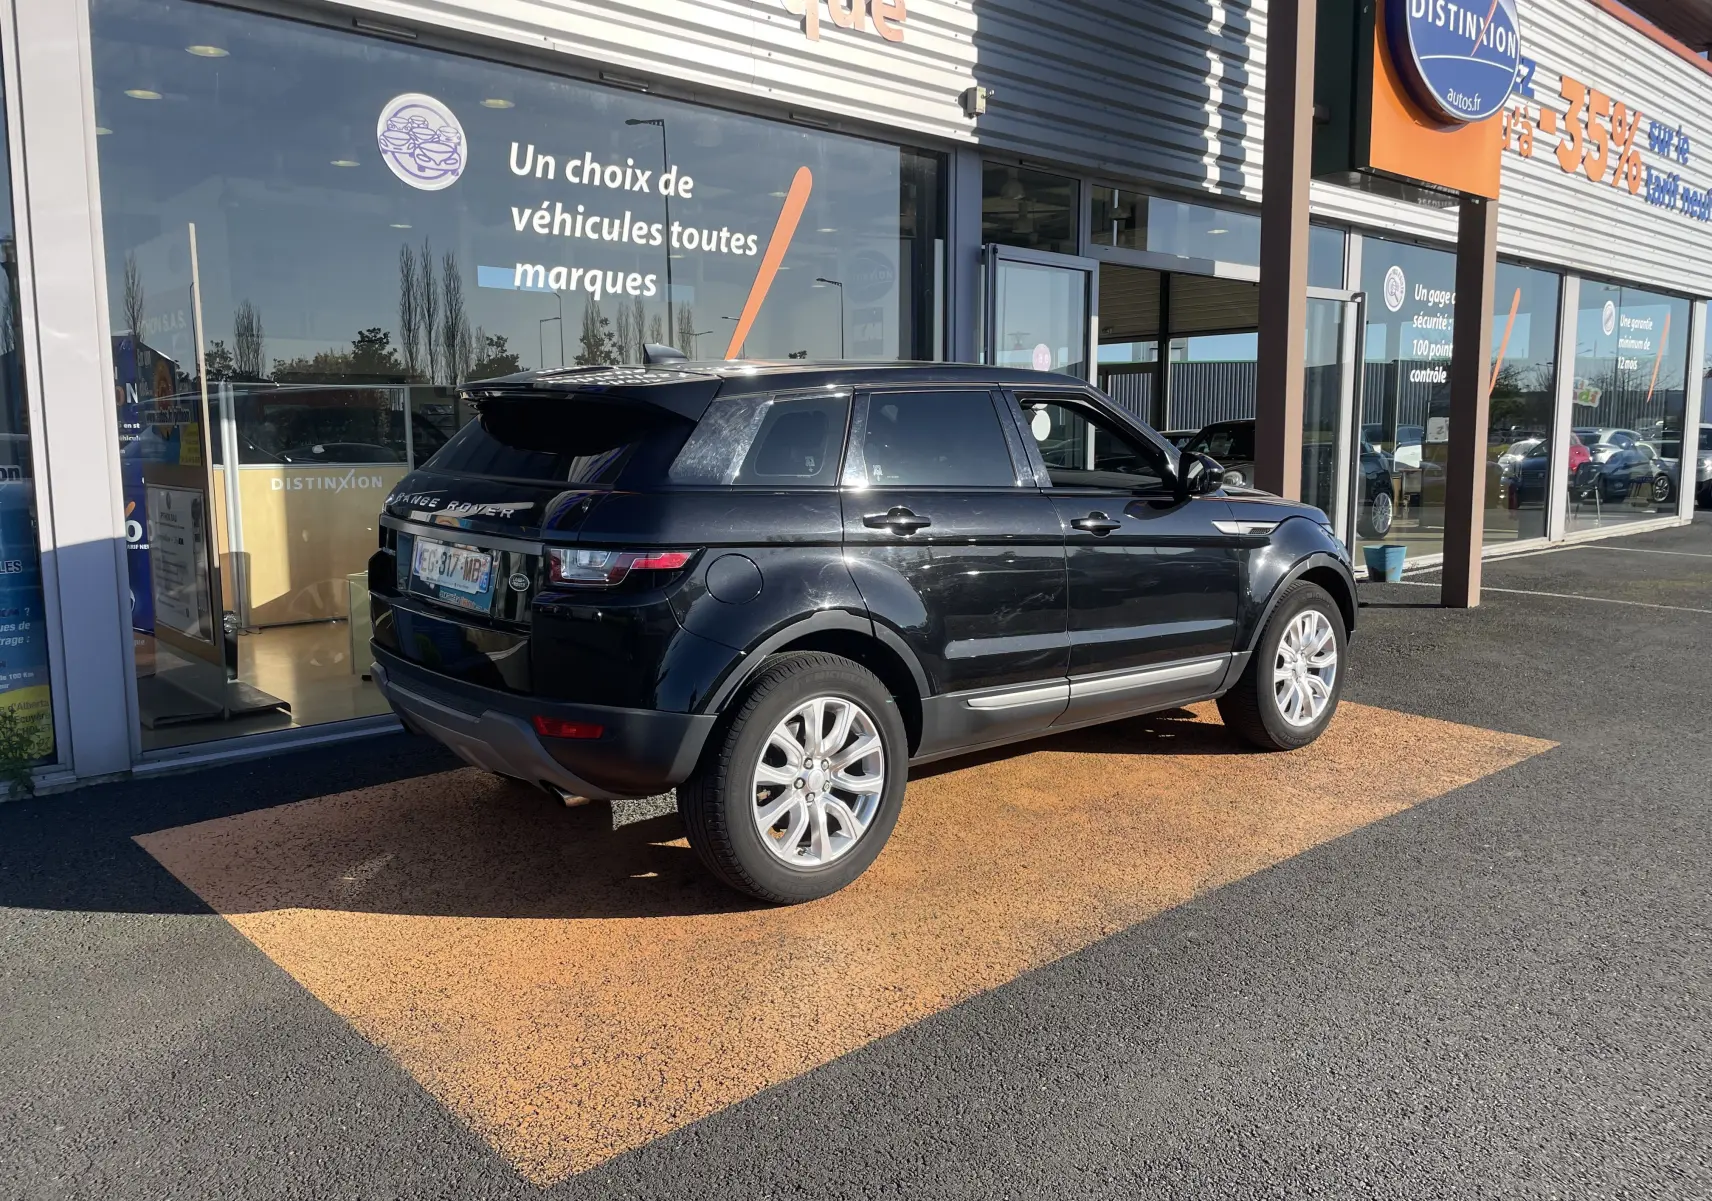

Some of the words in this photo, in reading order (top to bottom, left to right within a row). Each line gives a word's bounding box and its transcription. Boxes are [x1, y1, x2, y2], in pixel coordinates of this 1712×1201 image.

[1411, 0, 1516, 58] DISTINXION
[1447, 88, 1481, 111] autos.fr
[1649, 121, 1674, 158] sur
[1676, 125, 1690, 165] le
[509, 142, 555, 180] Un
[565, 151, 653, 193] choix
[658, 165, 694, 199] de
[1645, 166, 1680, 210] tarif
[511, 201, 663, 246] véhicules
[671, 221, 758, 256] toutes
[514, 262, 657, 301] marques
[1414, 283, 1427, 301] Un
[1428, 289, 1450, 307] gage
[1620, 314, 1632, 327] Une
[1631, 317, 1653, 331] garantie
[1412, 339, 1429, 356] 100
[1618, 336, 1643, 350] minimum
[1410, 366, 1447, 383] contrôle
[1625, 357, 1638, 370] mois
[271, 470, 383, 493] DISTINXION
[395, 492, 441, 508] RANGE
[446, 499, 515, 519] ROVER
[18, 621, 31, 630] de
